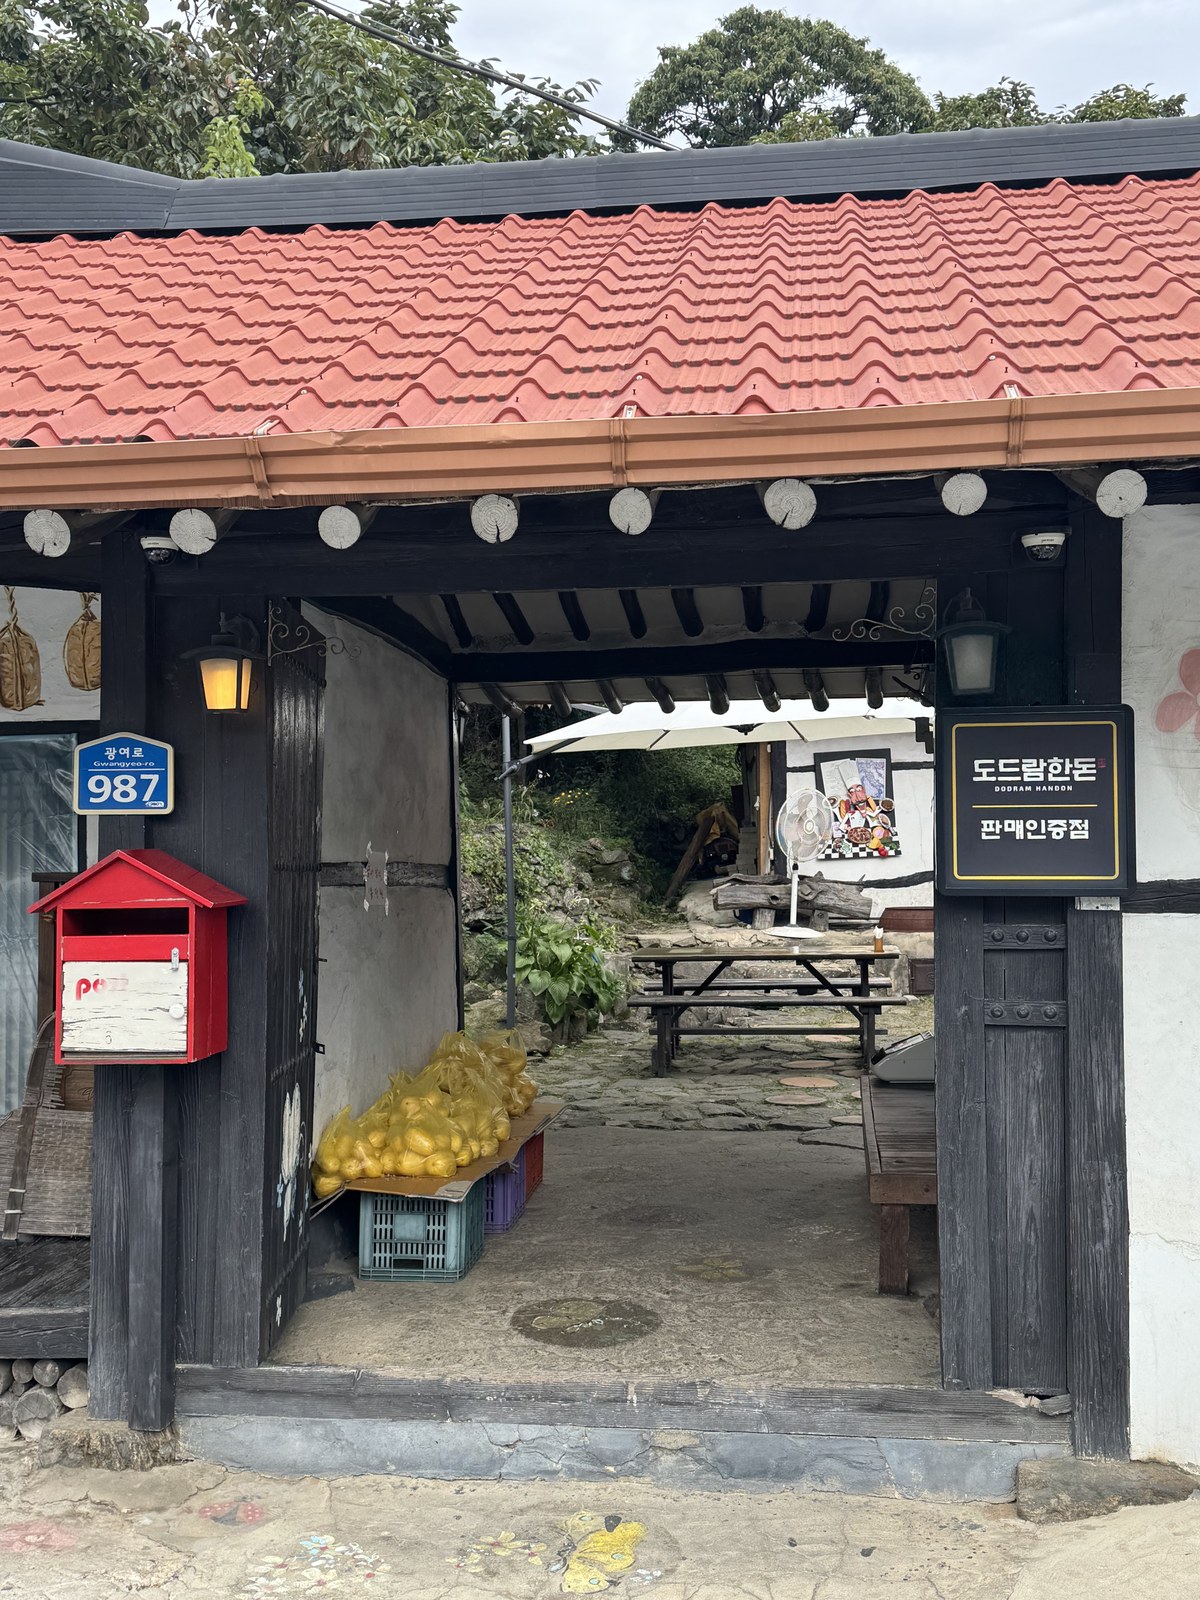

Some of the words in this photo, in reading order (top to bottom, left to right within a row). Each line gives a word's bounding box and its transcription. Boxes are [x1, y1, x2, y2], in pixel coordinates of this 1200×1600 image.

[93, 760, 155, 768] Gwangyeo-ro
[104, 747, 144, 760] 광여로
[972, 757, 1097, 782] 도드람한돈
[87, 774, 160, 804] 987
[980, 819, 1089, 840] 판매인증점
